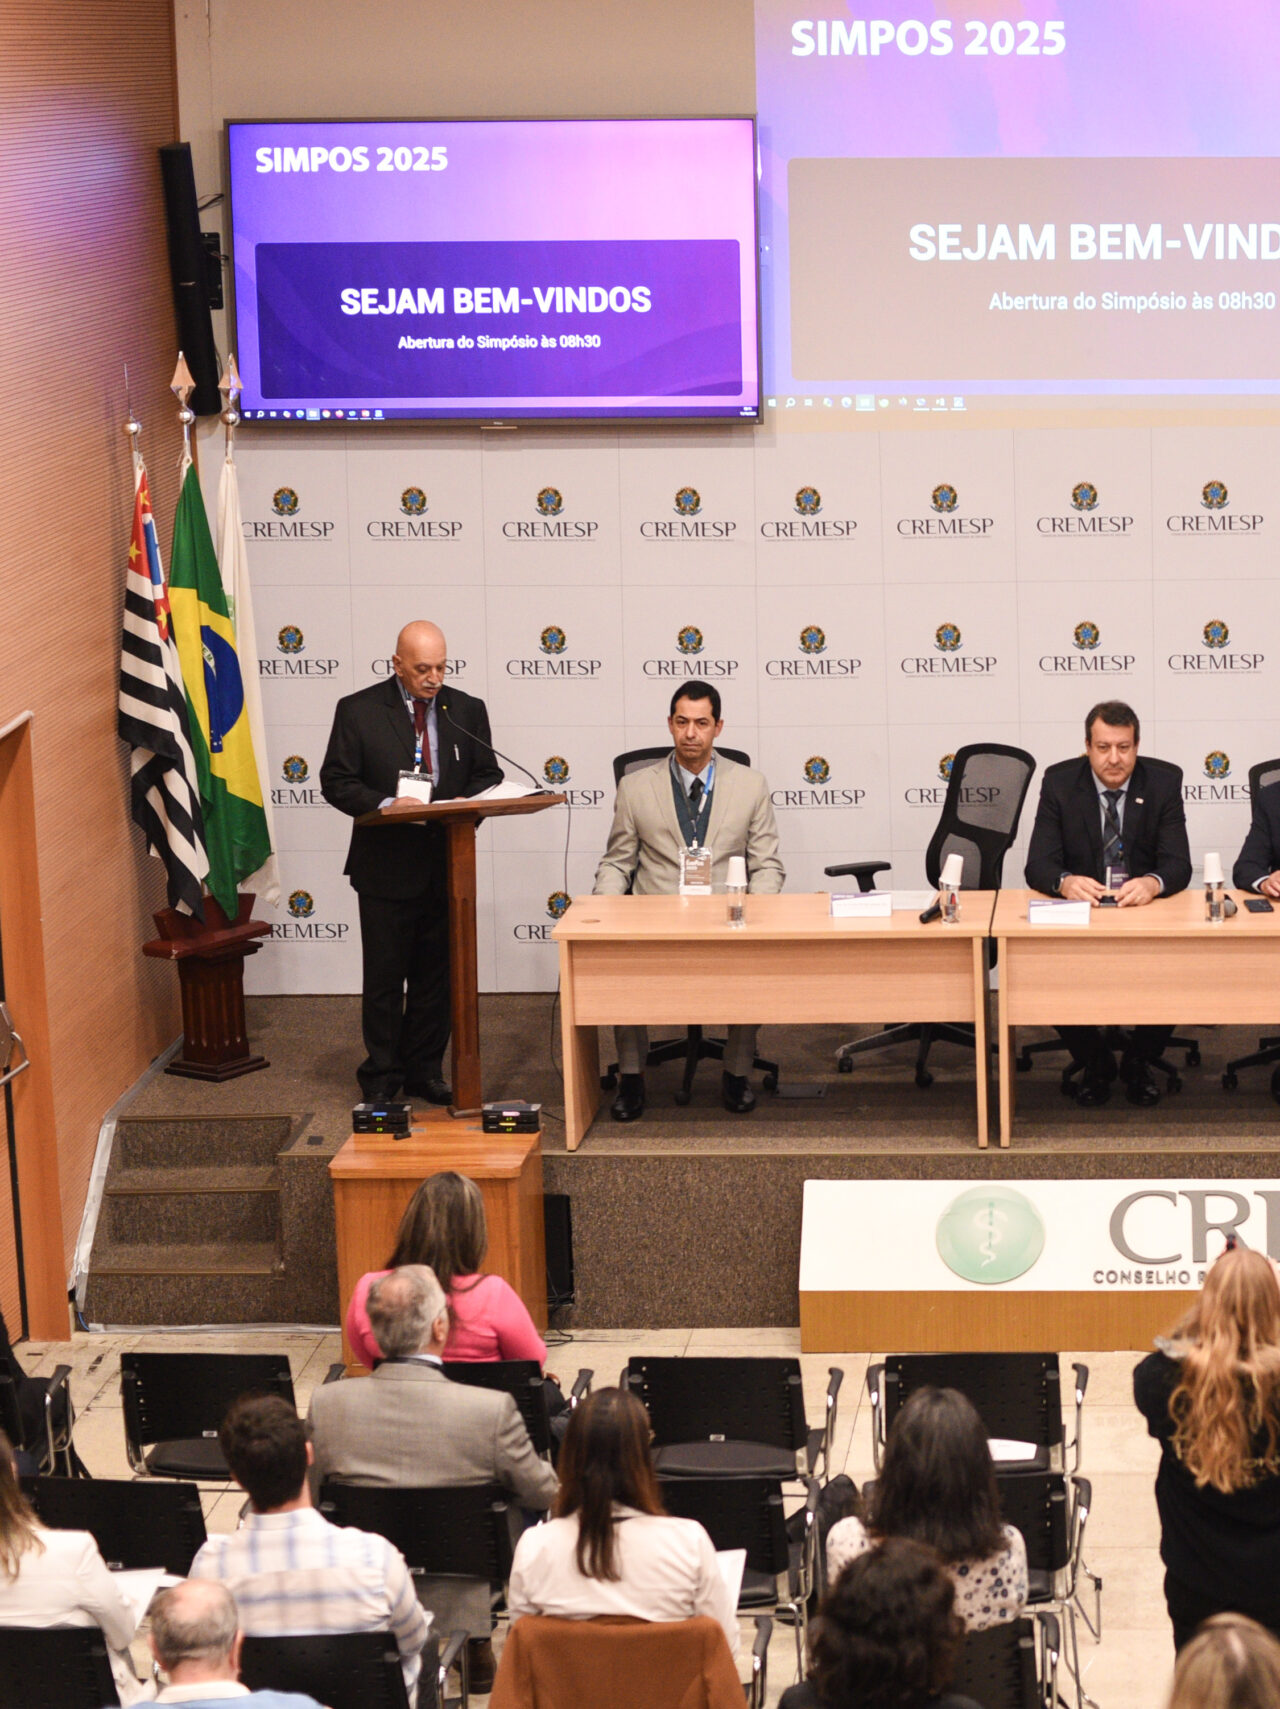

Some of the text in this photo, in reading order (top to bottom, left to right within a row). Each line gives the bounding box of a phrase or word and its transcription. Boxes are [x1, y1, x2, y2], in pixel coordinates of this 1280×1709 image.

[792, 20, 1065, 56] SIMPOS 2025
[256, 146, 448, 172] SIMPOS 2025
[910, 224, 1055, 260] SEJAM
[341, 286, 651, 315] SEJAM BEM-VINDOS
[989, 291, 1275, 313] Abertura do Simpósio às 08h30
[398, 335, 601, 350] Abertura do Simpósio às 08h30
[242, 522, 334, 537] CREMESP
[367, 522, 462, 536] CREMESP
[503, 522, 598, 537] CREMESP
[640, 522, 736, 536] CREMESP
[761, 521, 857, 537] CREMESP
[897, 519, 993, 534] CREMESP
[1037, 517, 1133, 532] CREMESP
[1167, 515, 1263, 531] CREMESP
[257, 661, 339, 675] REMESP
[507, 661, 601, 675] CREMESP
[643, 661, 738, 675] CREMESP
[766, 660, 861, 675] CREMESP
[901, 657, 997, 672] CREMESP
[1039, 656, 1135, 671] CREMESP
[1168, 654, 1264, 669] CREMESP
[771, 790, 865, 805] CREMESP
[1183, 785, 1251, 801] REMES
[1094, 1270, 1190, 1284] CONSELHO
